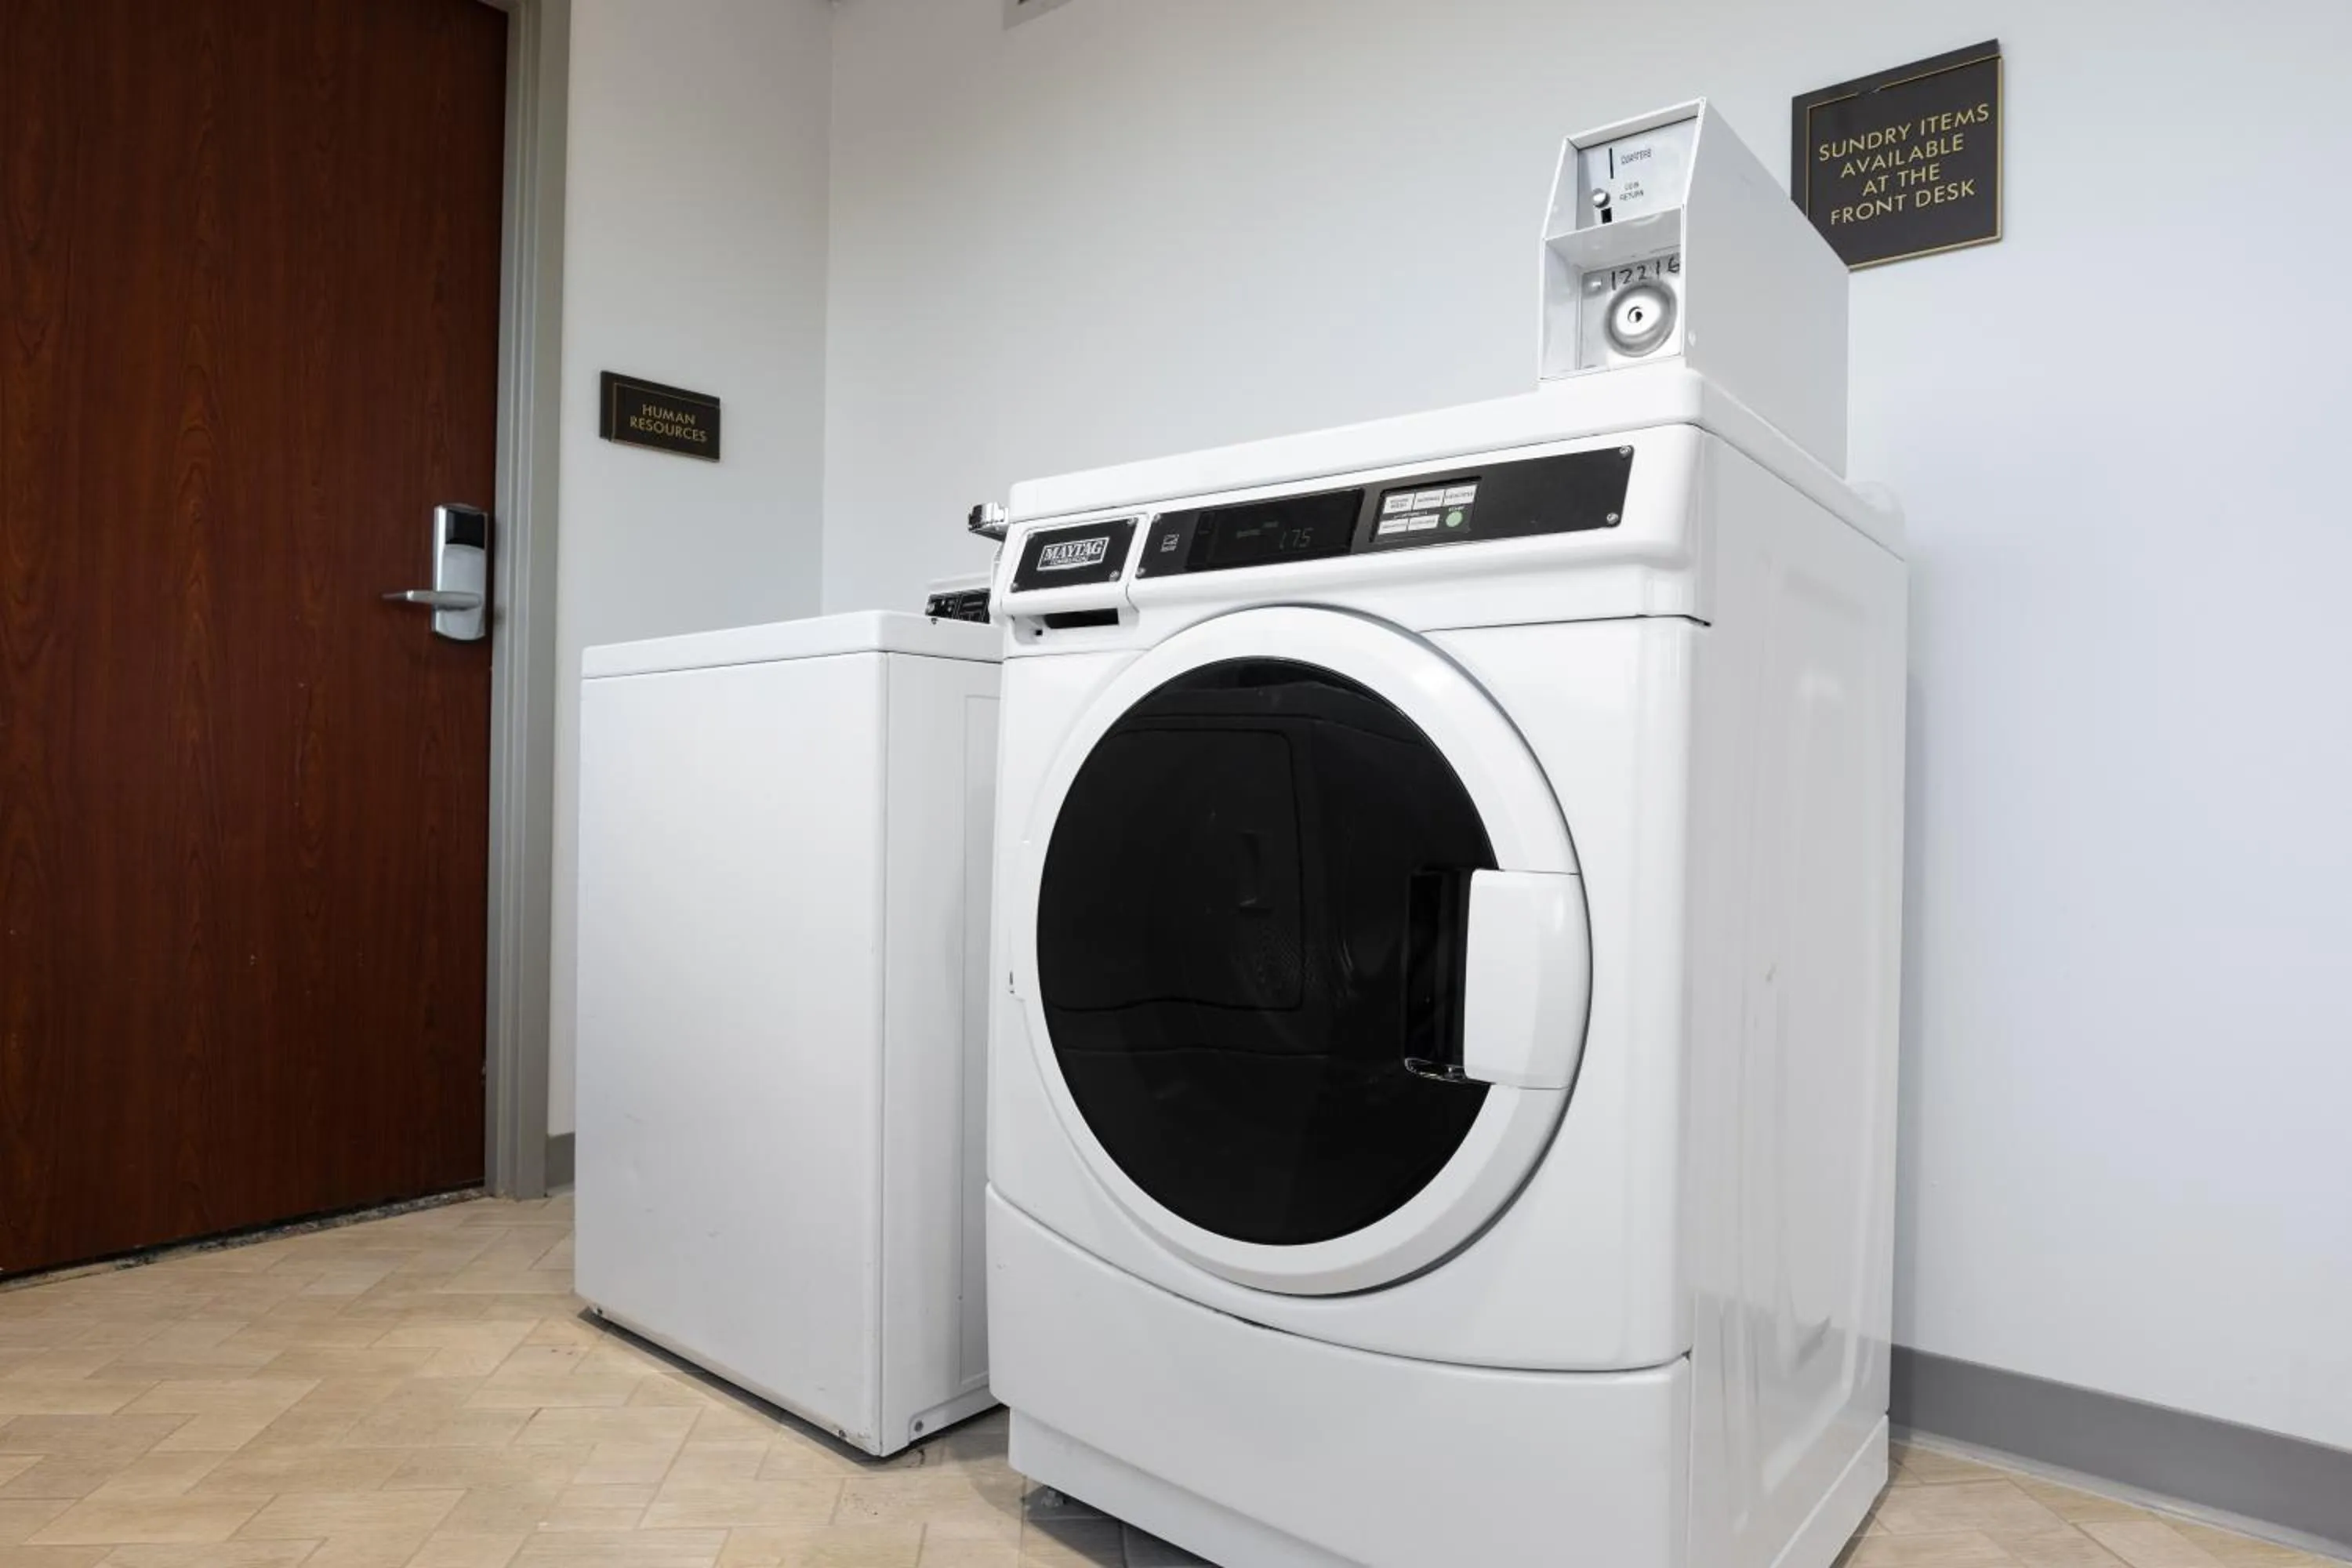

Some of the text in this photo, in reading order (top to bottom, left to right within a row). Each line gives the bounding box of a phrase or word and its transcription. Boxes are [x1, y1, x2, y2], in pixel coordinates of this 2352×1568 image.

[1818, 103, 1989, 161] SUNDRY ITEMS
[1840, 132, 1964, 178] AVAILABLE
[1862, 163, 1940, 196] AT THE
[1831, 179, 1975, 225] FRONT DESK
[630, 416, 707, 443] RESOURCES
[642, 404, 695, 426] HUMAN
[1044, 540, 1103, 560] MAYTAG
